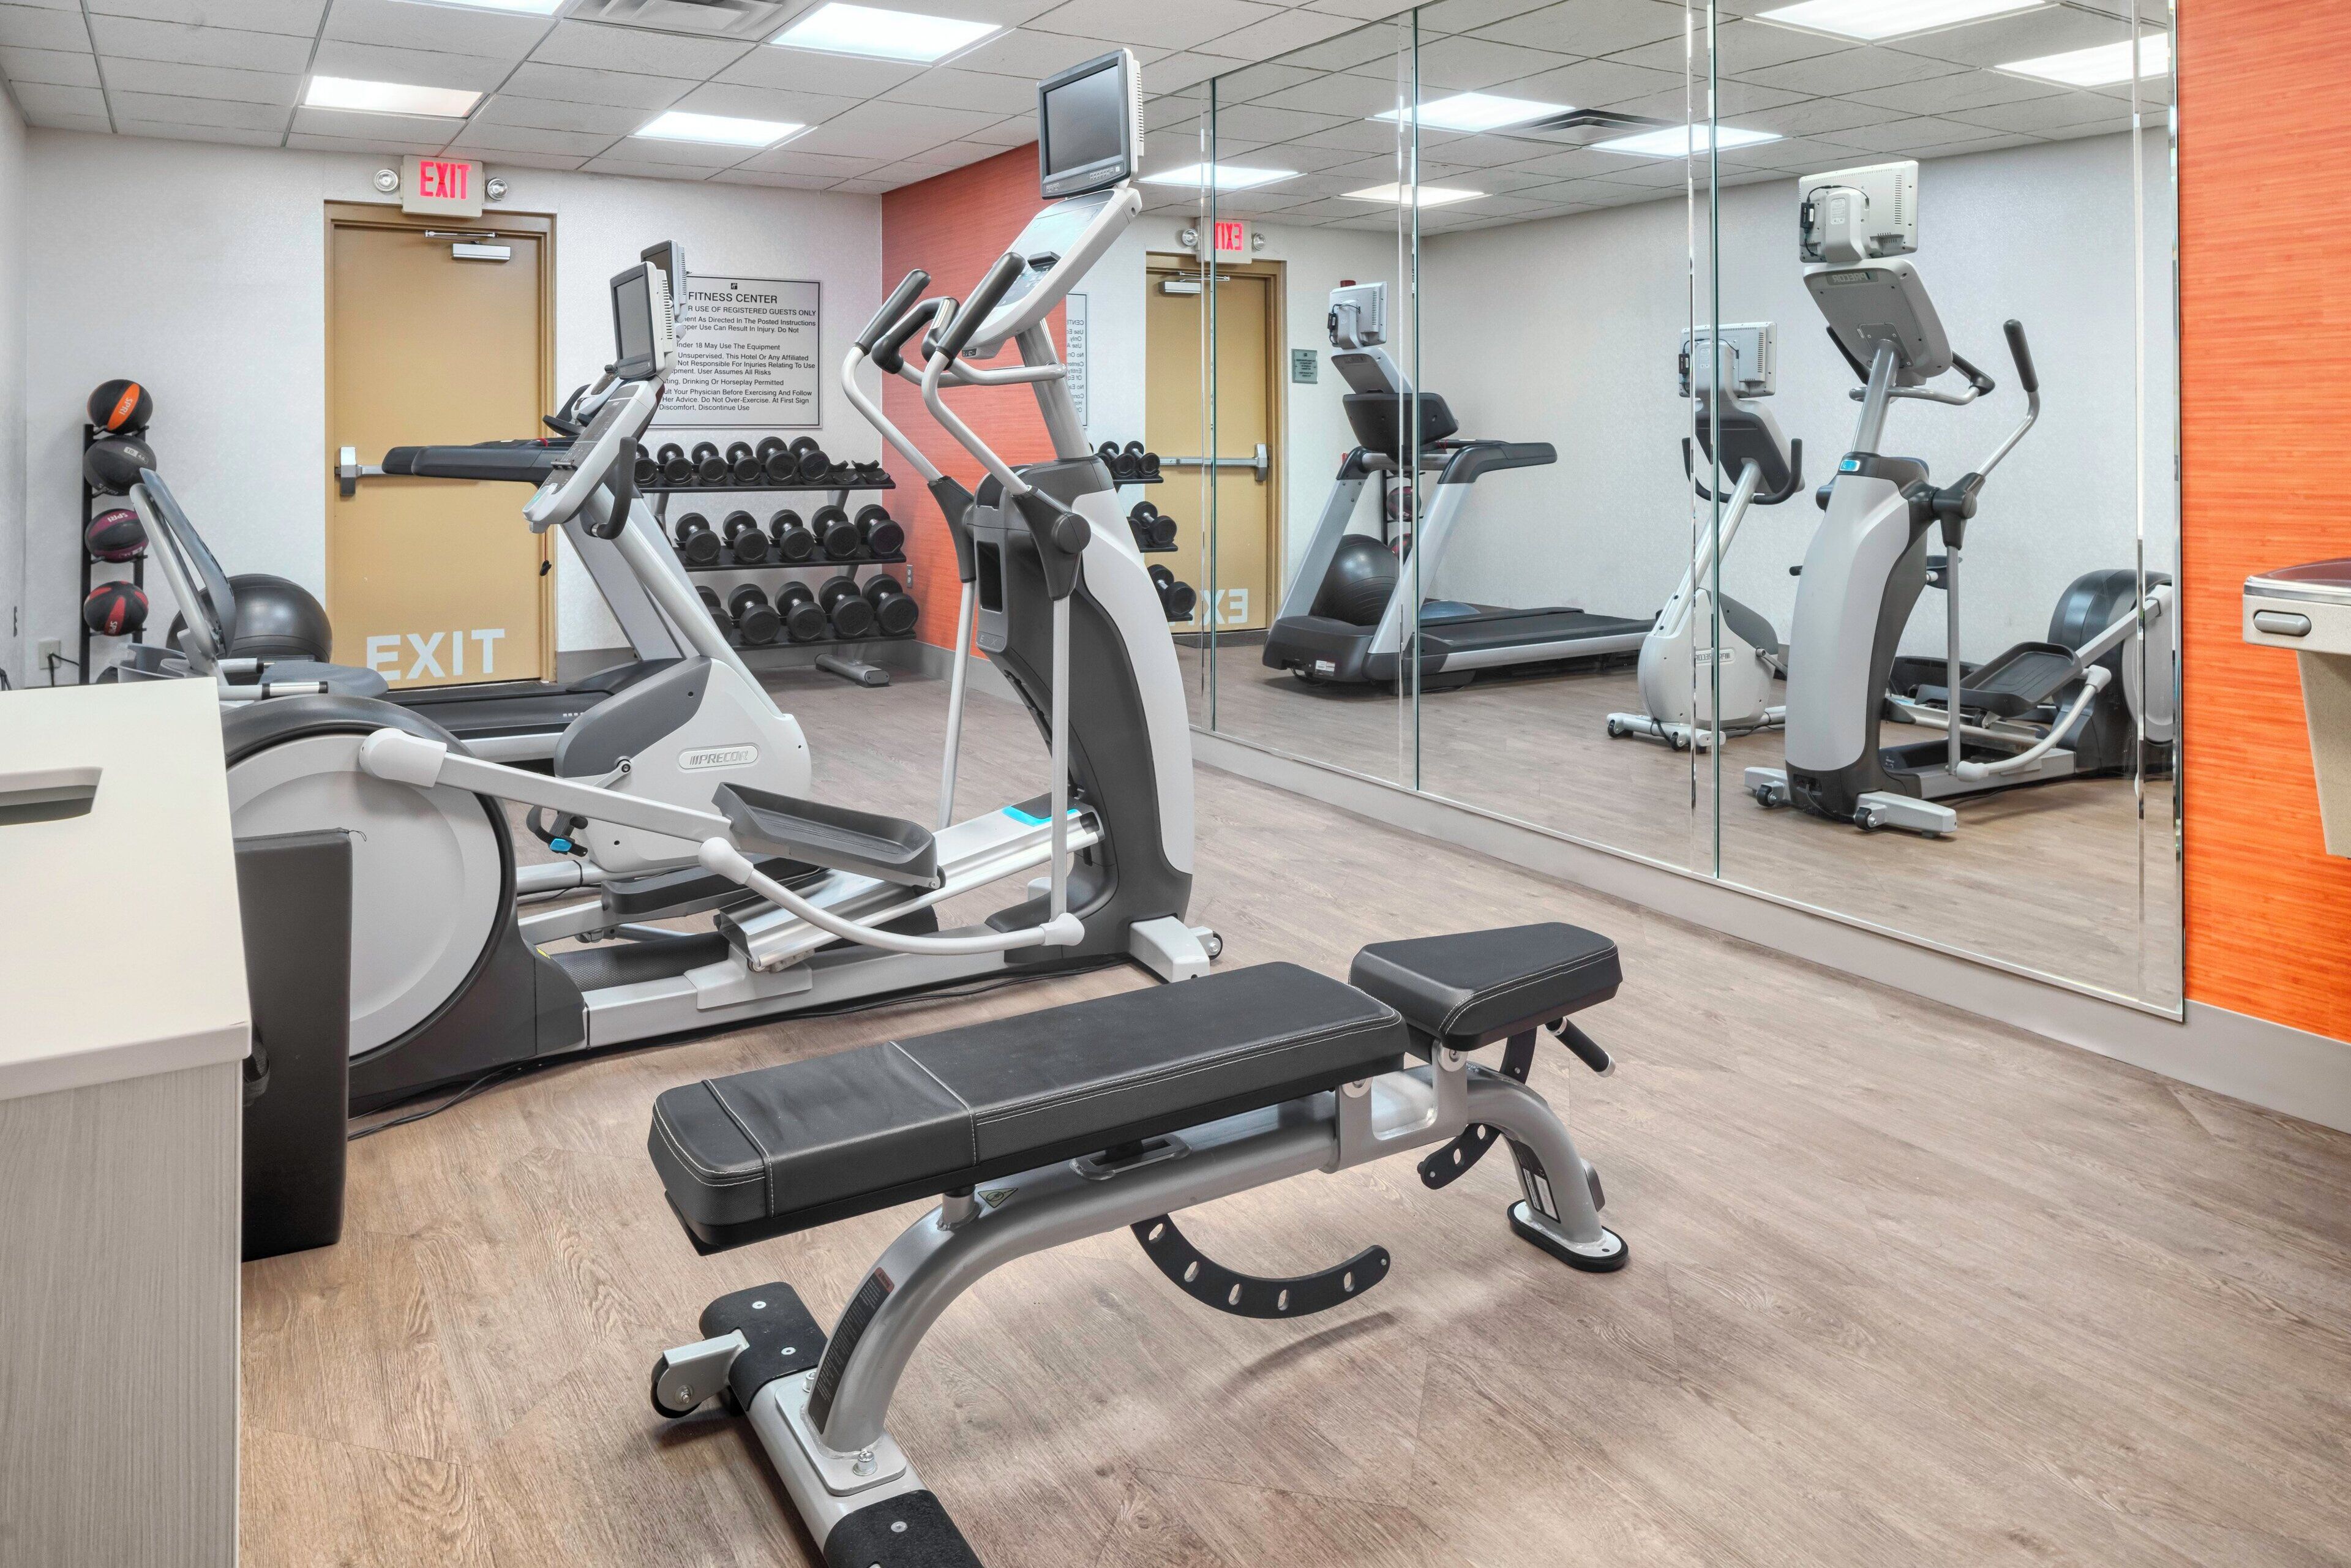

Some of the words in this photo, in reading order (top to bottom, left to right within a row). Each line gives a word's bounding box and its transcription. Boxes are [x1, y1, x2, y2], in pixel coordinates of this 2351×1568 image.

[421, 161, 471, 199] EXIT
[688, 292, 733, 301] FITNESS
[736, 294, 777, 304] CENTER
[119, 398, 133, 415] SPRI
[107, 512, 128, 522] SPRI
[367, 628, 506, 681] EXIT
[698, 751, 748, 765] PRECOR
